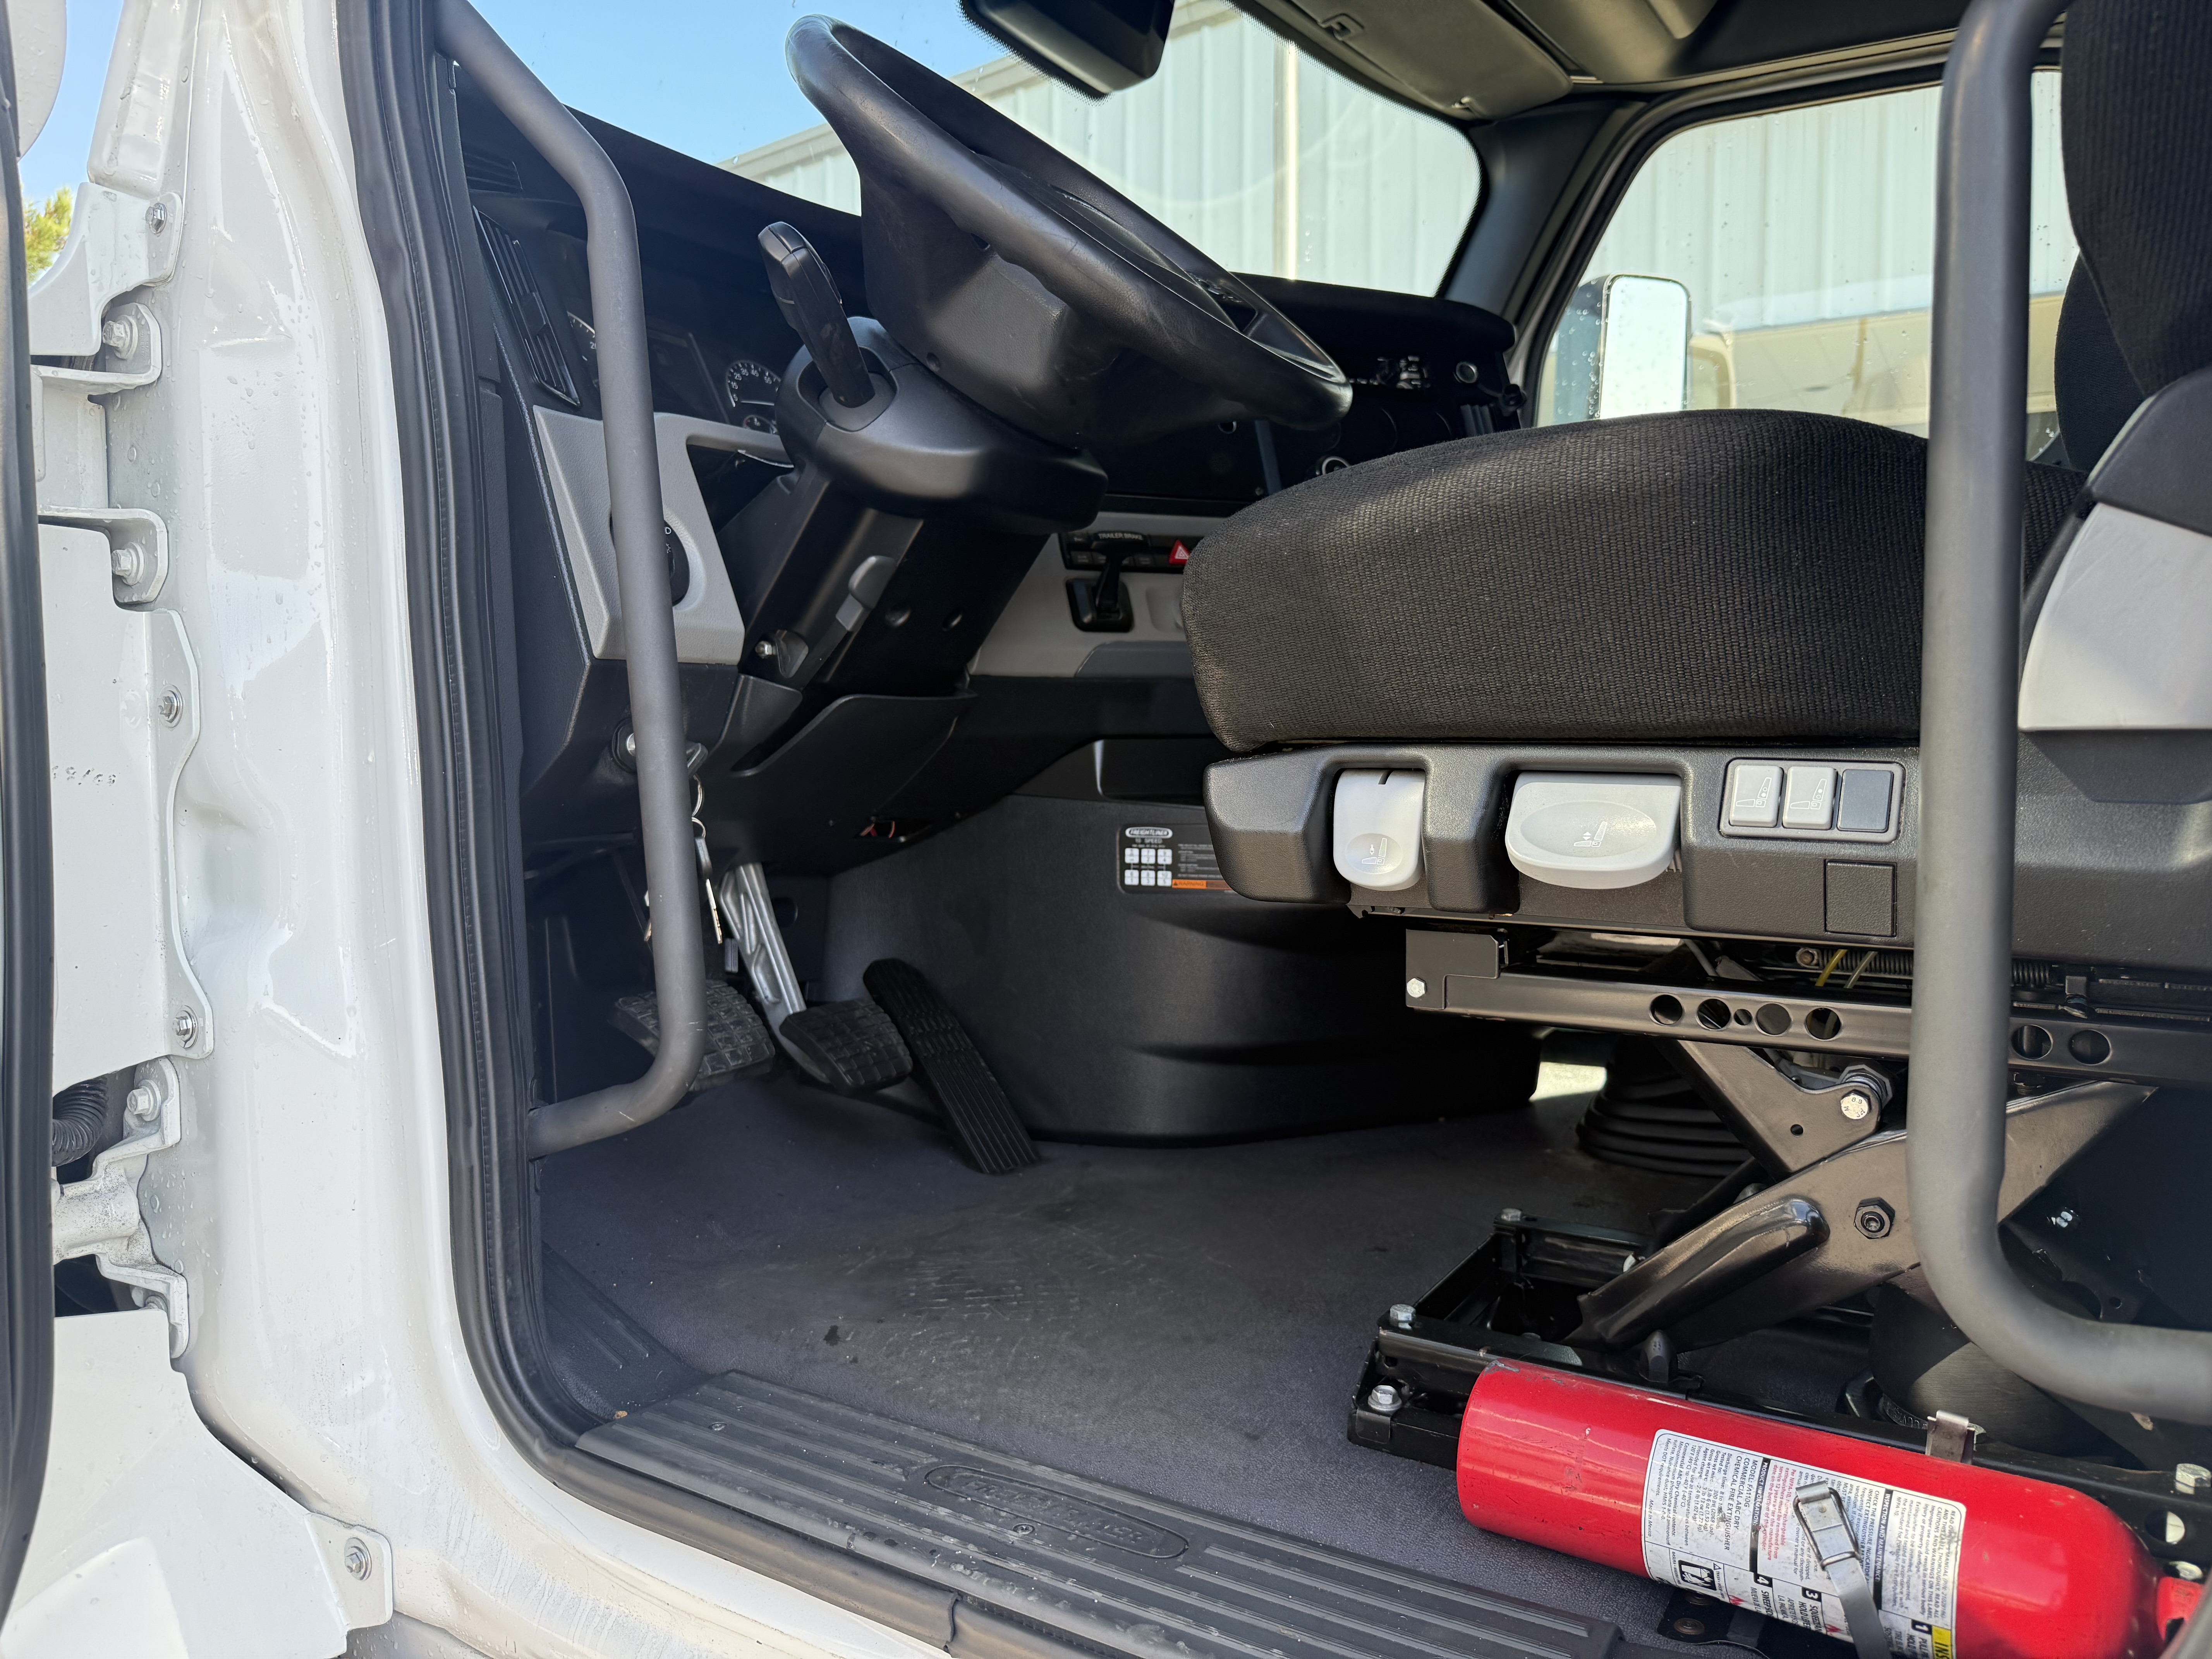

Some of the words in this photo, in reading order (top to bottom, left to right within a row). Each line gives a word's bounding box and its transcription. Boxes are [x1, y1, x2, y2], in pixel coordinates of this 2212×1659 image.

[1666, 1456, 1674, 1478] Nuisance
[1671, 1441, 1684, 1480] Monoammonium
[1679, 1442, 1689, 1469] Commercial
[1693, 1445, 1702, 1466] Intended
[1700, 1447, 1709, 1462] Agent
[1722, 1453, 1732, 1475] Discharge
[1654, 1462, 1665, 1497] requirements.
[1730, 1455, 1742, 1487] CHEMICAL
[1736, 1457, 1750, 1499] COMMERCIAL
[1748, 1459, 1758, 1483] MODEL:
[1759, 1462, 1768, 1485] PRODUCT
[1778, 1467, 1790, 1500] extinguishers
[1666, 1480, 1675, 1508] phosphate
[1744, 1484, 1752, 1508] FA110G
[1785, 1477, 1794, 1498] NFPA-10,
[1857, 1487, 1867, 1512] frequently
[1865, 1489, 1874, 1509] INSPECT
[1684, 1490, 1692, 1524] temperatures
[1881, 1493, 1890, 1524] INSPECTION
[1906, 1499, 1914, 1528] maintained
[1910, 1501, 1921, 1532] Extinguisher
[1926, 1504, 1935, 1528] Improper
[1724, 1502, 1733, 1551] EXTINGUISHER
[1860, 1509, 1869, 1549] EXTINGUISHER
[1934, 1507, 1942, 1533] CAUTIONS
[1875, 1538, 1883, 1582] MAINTENANCE:
[1756, 1576, 1769, 1584] 4
[1928, 1580, 1933, 1589] ON
[1761, 1590, 1771, 1608] SWEEP
[1805, 1590, 1819, 1599] 3
[1798, 1601, 1808, 1616] HOLD
